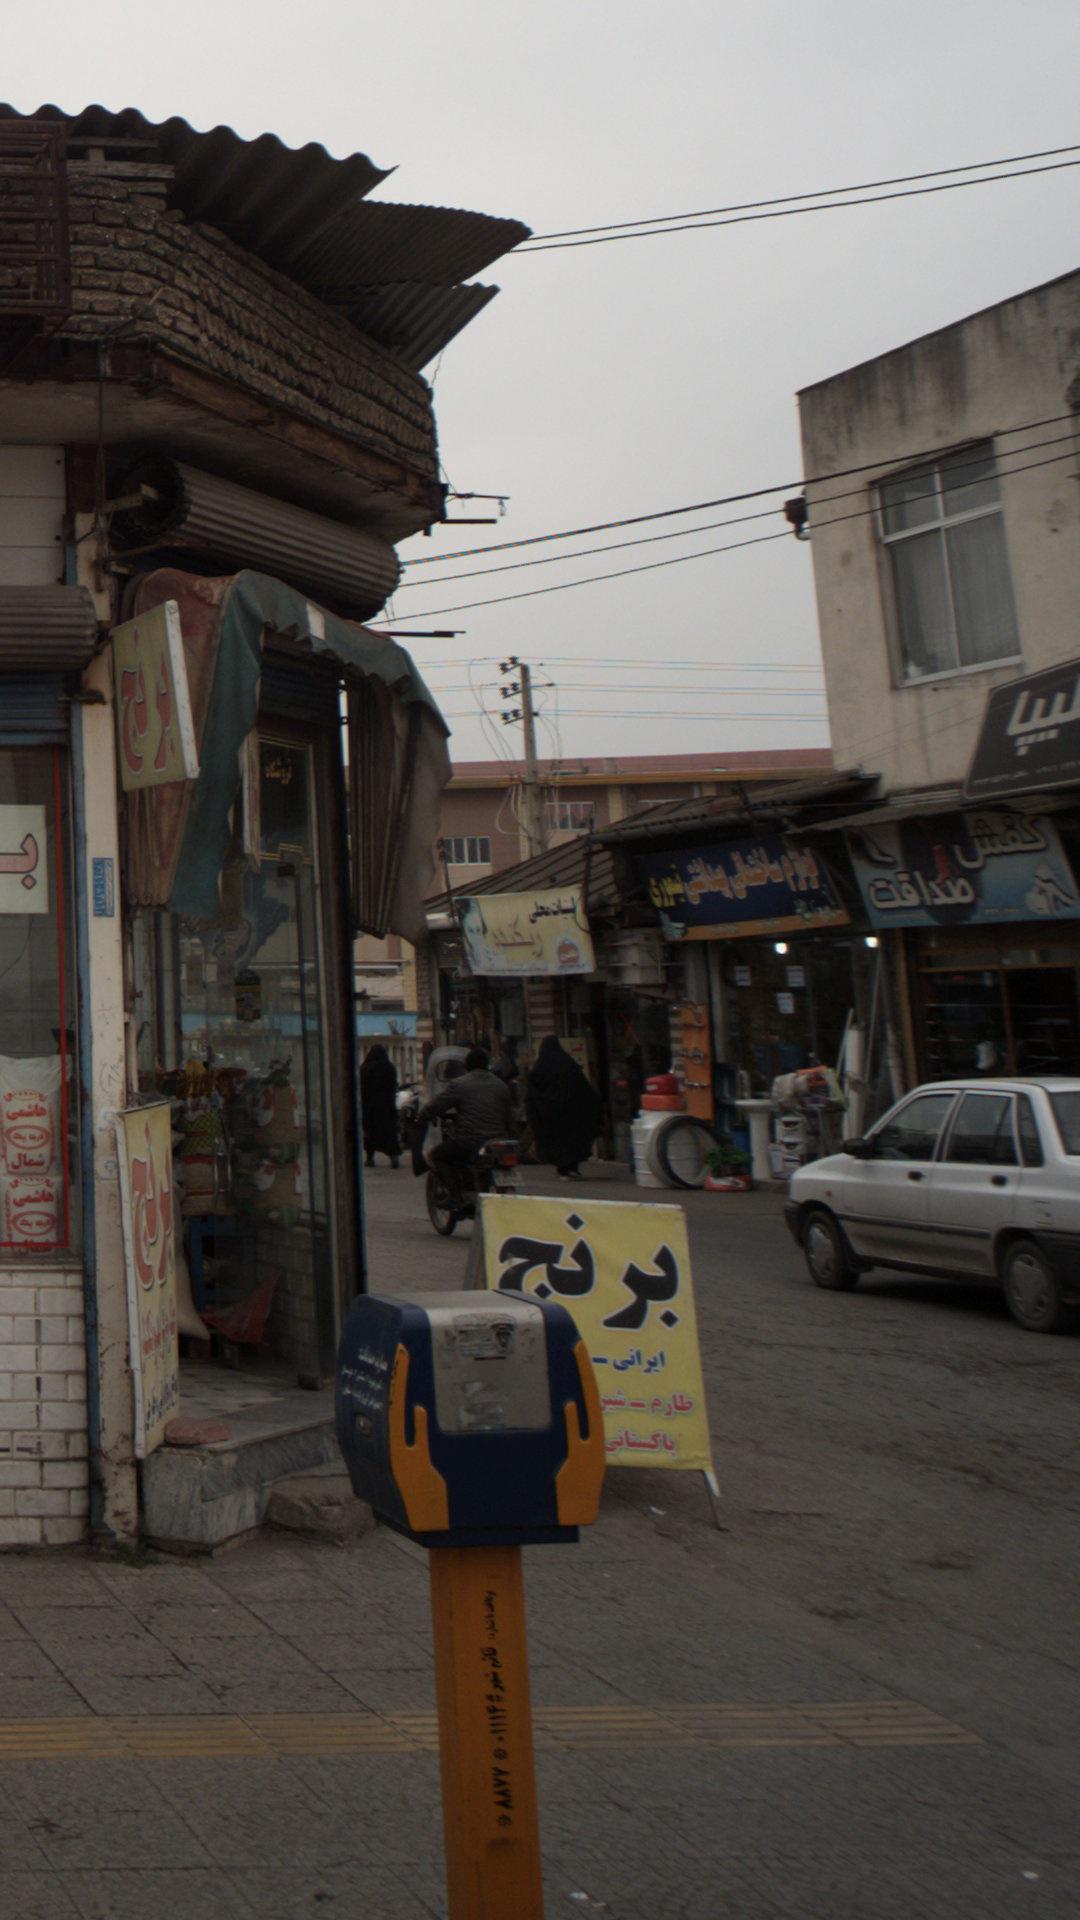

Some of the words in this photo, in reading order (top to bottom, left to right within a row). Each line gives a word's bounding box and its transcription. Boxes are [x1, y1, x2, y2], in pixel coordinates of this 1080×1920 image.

[121, 627, 178, 774] برنج
[954, 812, 1047, 870] کفش
[868, 869, 976, 910] صداقت
[498, 1213, 679, 1330] برنج
[612, 1348, 666, 1374] ایرانی
[651, 1394, 694, 1417] طارم
